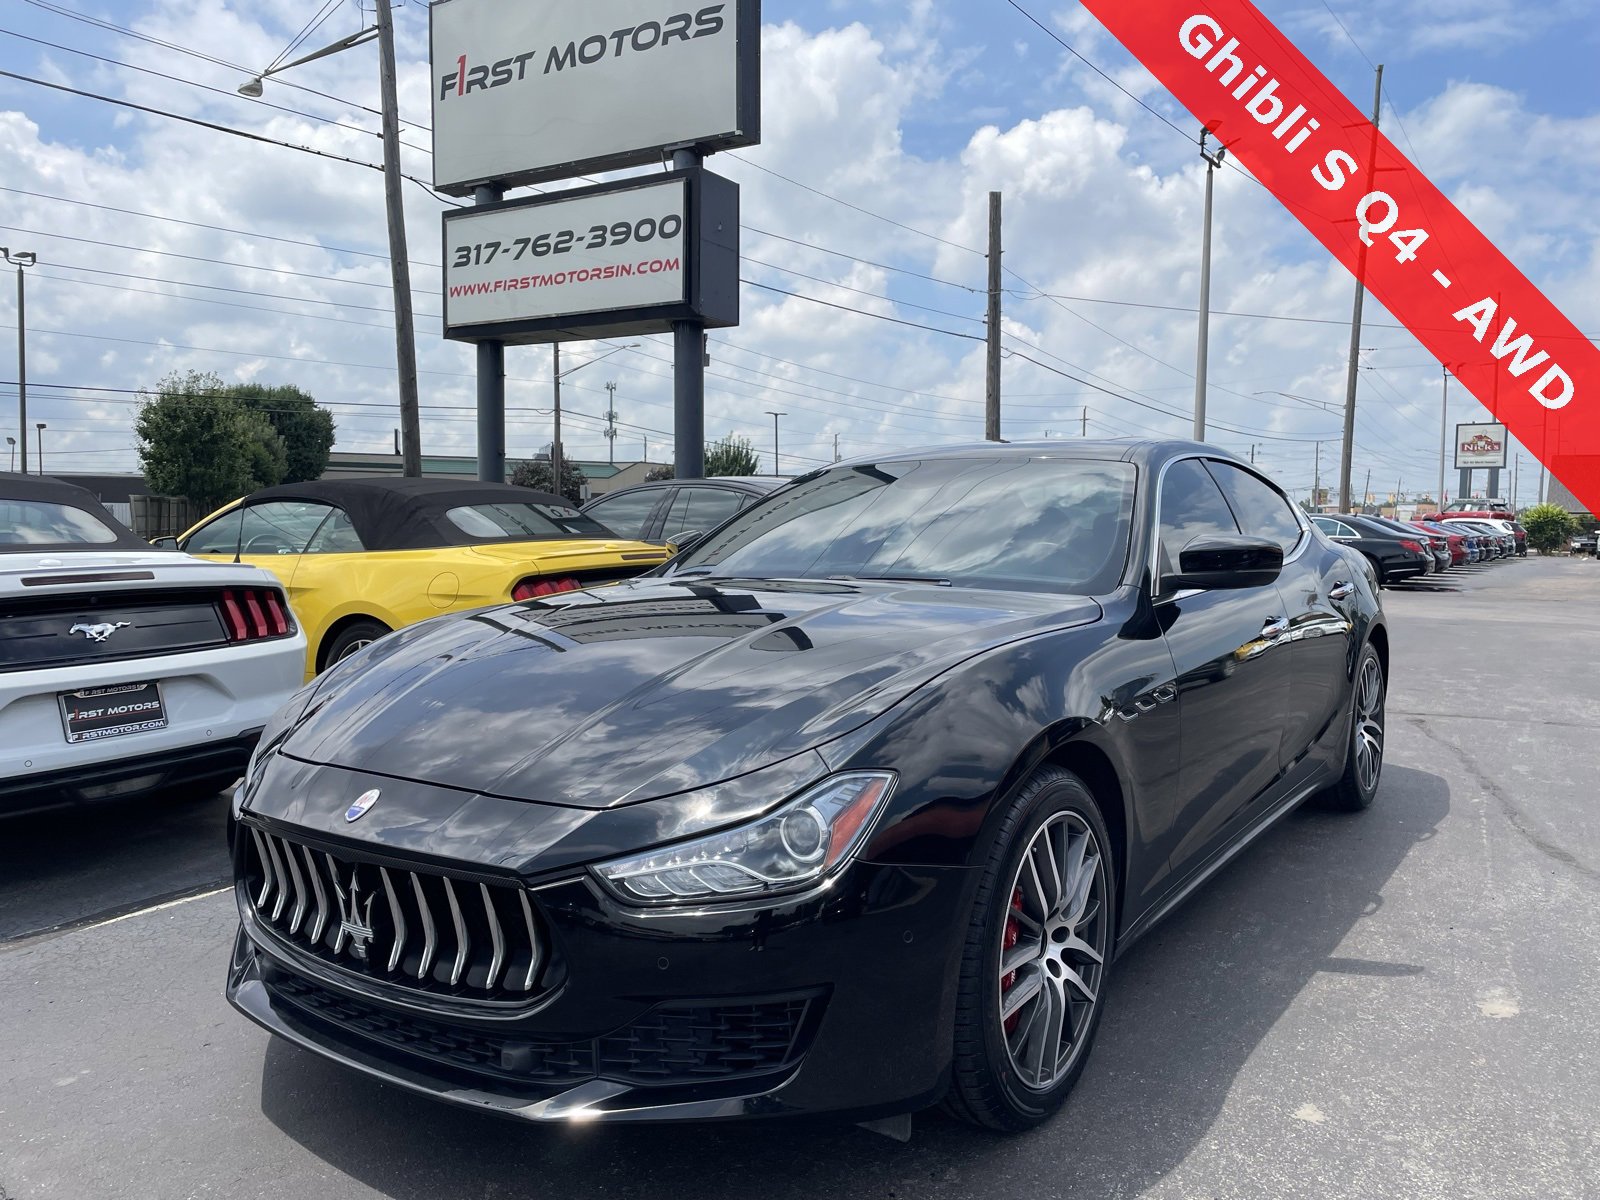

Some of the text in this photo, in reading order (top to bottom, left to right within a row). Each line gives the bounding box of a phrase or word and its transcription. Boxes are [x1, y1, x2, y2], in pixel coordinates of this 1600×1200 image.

[543, 4, 726, 75] MOTORS
[452, 214, 682, 269] 317-762-3900
[450, 258, 680, 298] WWW.FIRSTMOTORSIN.COM
[84, 688, 106, 696] FRST
[107, 700, 160, 715] MOTORS
